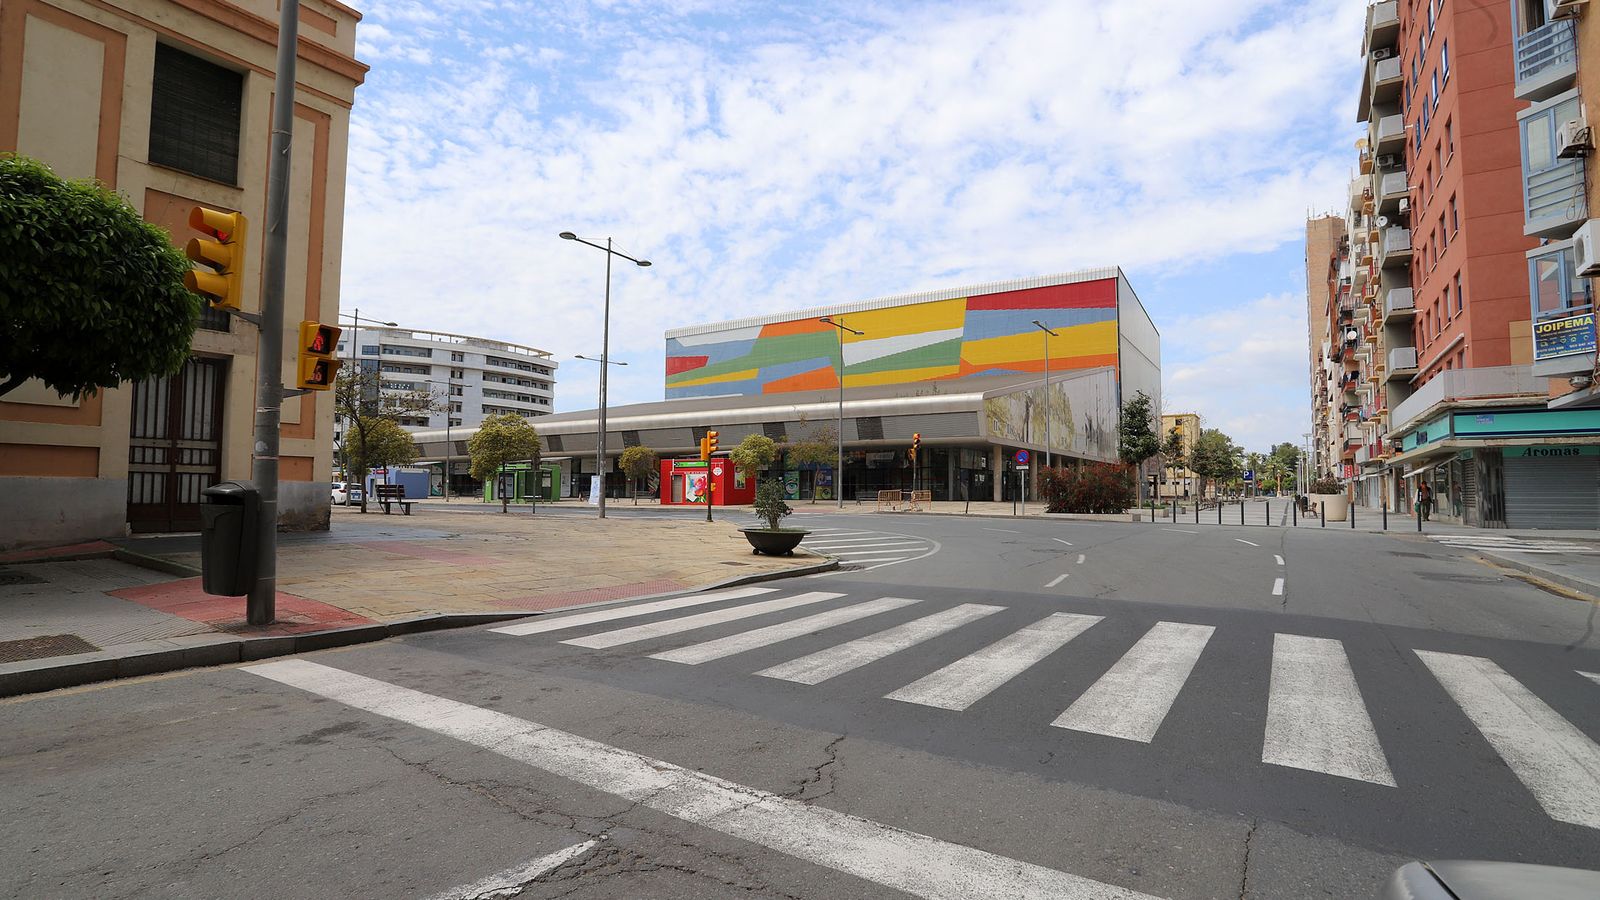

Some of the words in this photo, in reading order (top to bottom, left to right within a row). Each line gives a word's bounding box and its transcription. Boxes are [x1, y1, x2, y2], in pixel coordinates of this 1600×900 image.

[1536, 316, 1593, 334] JOIPEMA
[1522, 447, 1580, 457] Aromas
[1243, 470, 1250, 479] P
